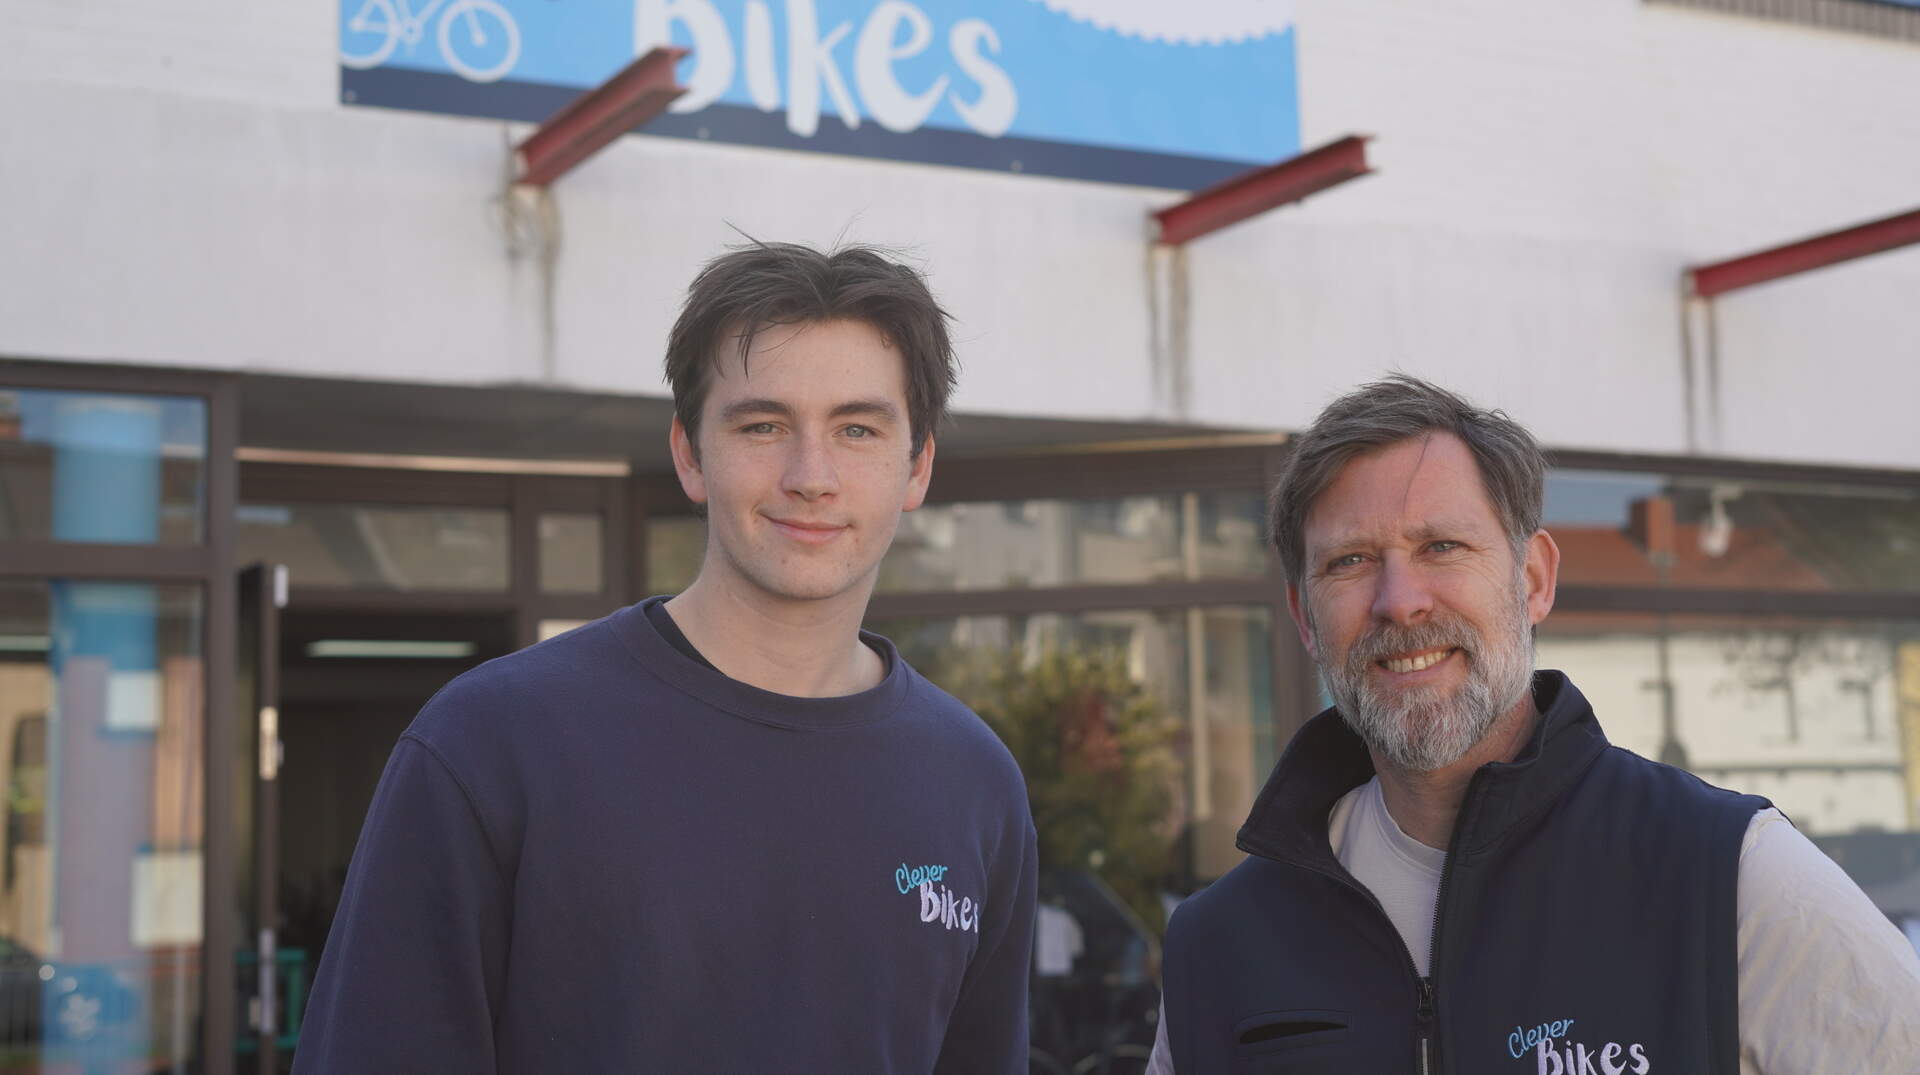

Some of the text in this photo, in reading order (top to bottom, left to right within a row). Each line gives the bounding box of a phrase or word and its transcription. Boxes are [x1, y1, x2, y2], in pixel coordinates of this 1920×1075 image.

[895, 862, 948, 894] Clever
[1508, 1018, 1574, 1059] Clever
[1537, 1038, 1650, 1075] Bikes
